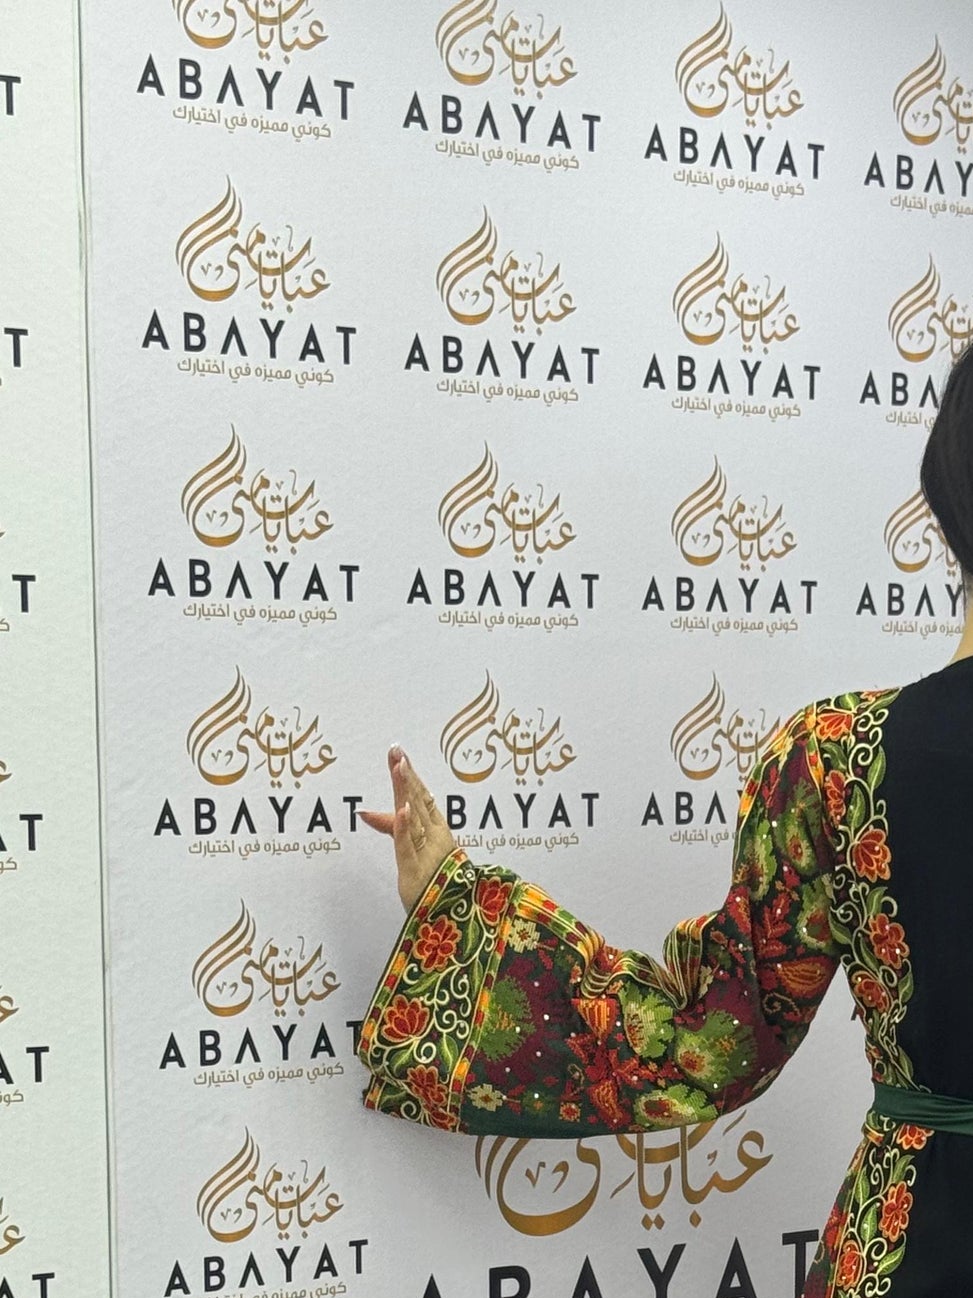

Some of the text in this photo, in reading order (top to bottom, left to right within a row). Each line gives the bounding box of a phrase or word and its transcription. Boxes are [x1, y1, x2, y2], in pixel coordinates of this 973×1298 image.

[136, 53, 355, 121] ABAYAT
[224, 112, 248, 135] في
[291, 120, 332, 143] كوني
[402, 91, 601, 152] ABAYAT
[644, 123, 825, 180] ABAYAT
[141, 309, 357, 365] ABAYAT
[404, 333, 600, 385] ABAYAT
[228, 362, 252, 384] في
[294, 367, 335, 390] كوني
[642, 353, 821, 400] ABAYAT
[482, 382, 504, 403] في
[542, 386, 579, 408] كوني
[147, 557, 360, 602] ABAYAT
[406, 567, 600, 609] ABAYAT
[641, 576, 818, 614] ABAYAT
[855, 579, 966, 617] ABAY
[233, 604, 256, 626] في
[298, 605, 338, 628] كوني
[483, 611, 505, 633] في
[543, 612, 579, 634] كوني
[711, 617, 731, 637] في
[765, 617, 799, 638] كوني
[153, 796, 364, 836] ABAYAT
[446, 792, 600, 831] BAYAT
[238, 839, 261, 861] في
[302, 837, 341, 860] كوني
[163, 1238, 369, 1298] ABAYAT
